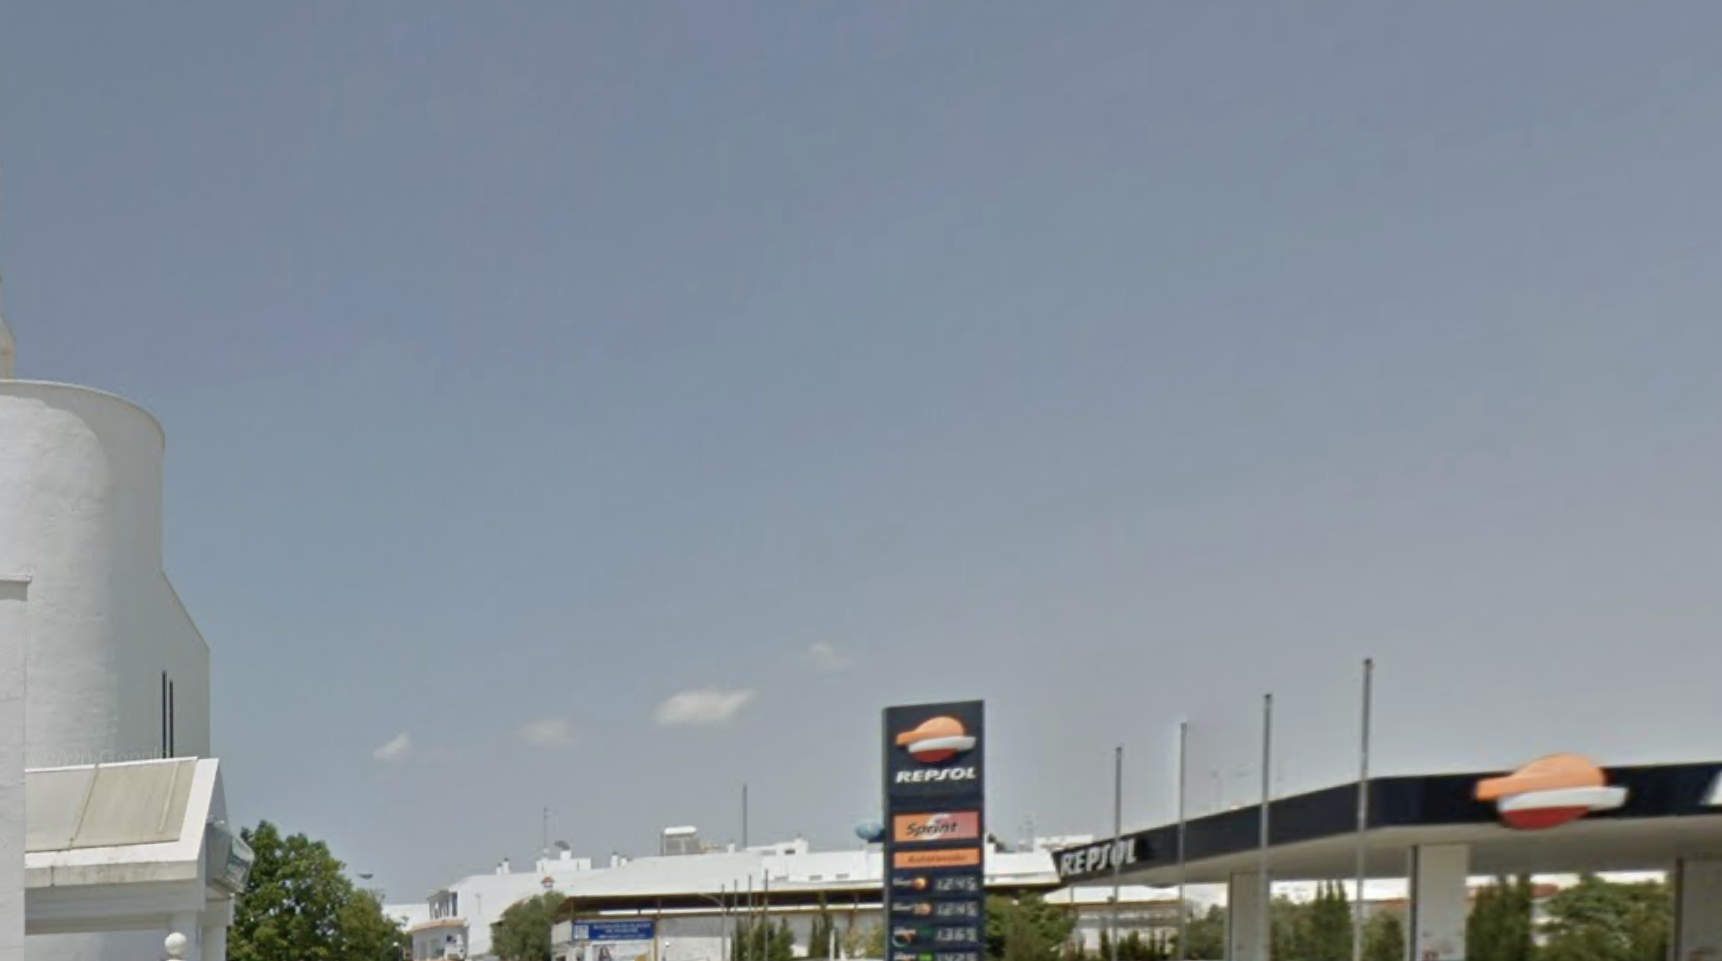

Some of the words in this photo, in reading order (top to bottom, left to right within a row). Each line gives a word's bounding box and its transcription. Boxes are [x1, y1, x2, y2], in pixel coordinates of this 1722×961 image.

[895, 766, 977, 784] REPSOL
[905, 821, 959, 839] Sprint
[1059, 838, 1137, 877] REPSOL
